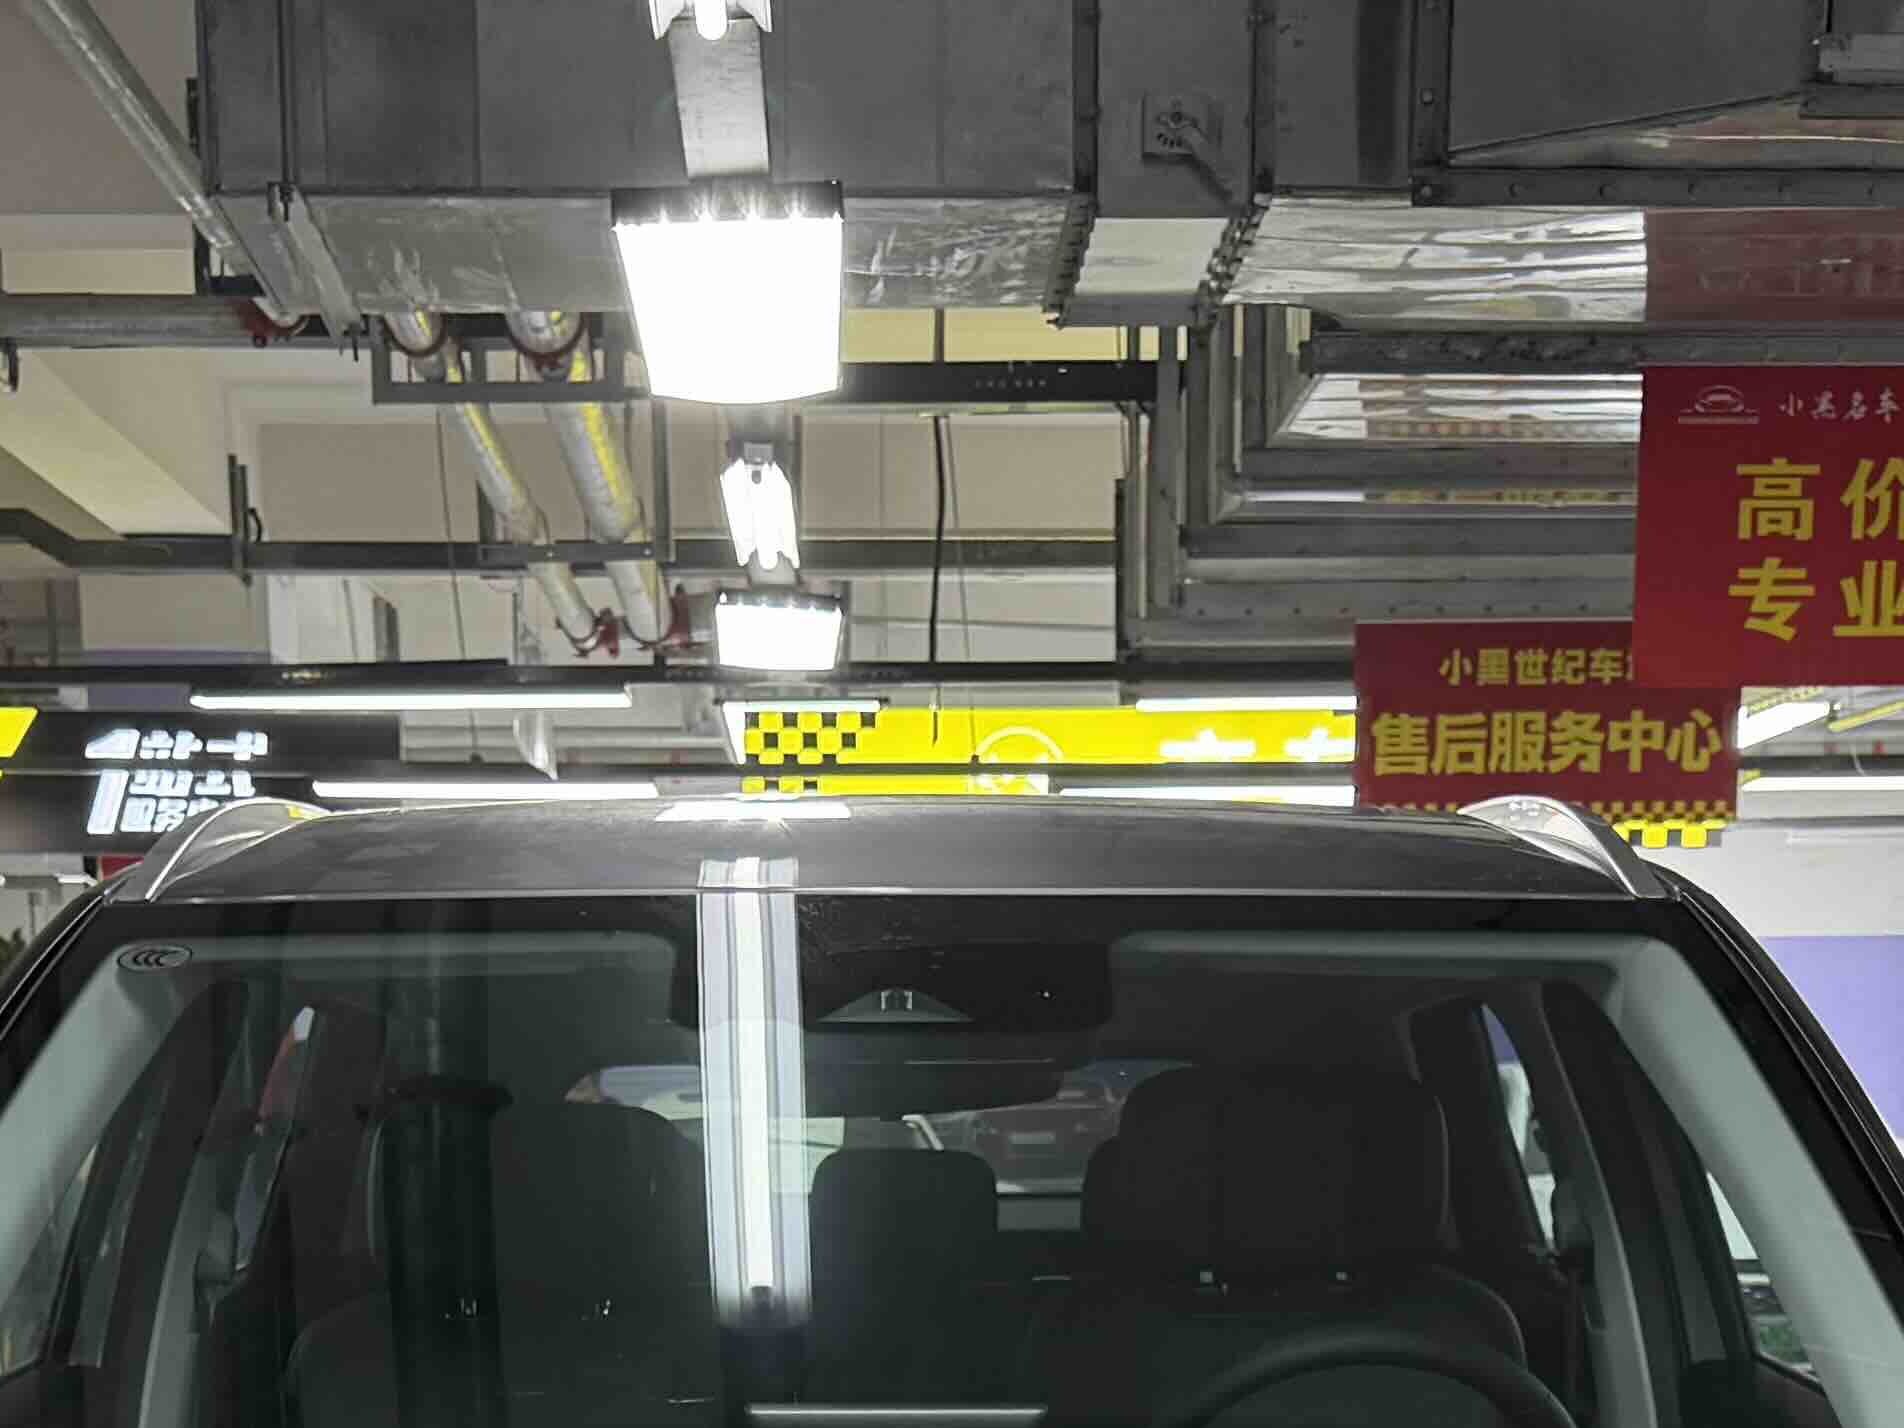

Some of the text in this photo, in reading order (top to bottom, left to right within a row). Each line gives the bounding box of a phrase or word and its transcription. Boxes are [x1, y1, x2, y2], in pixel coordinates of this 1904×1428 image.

[1438, 648, 1634, 687] 小黑世纪车
[1370, 709, 1723, 776] 售后服务中心
